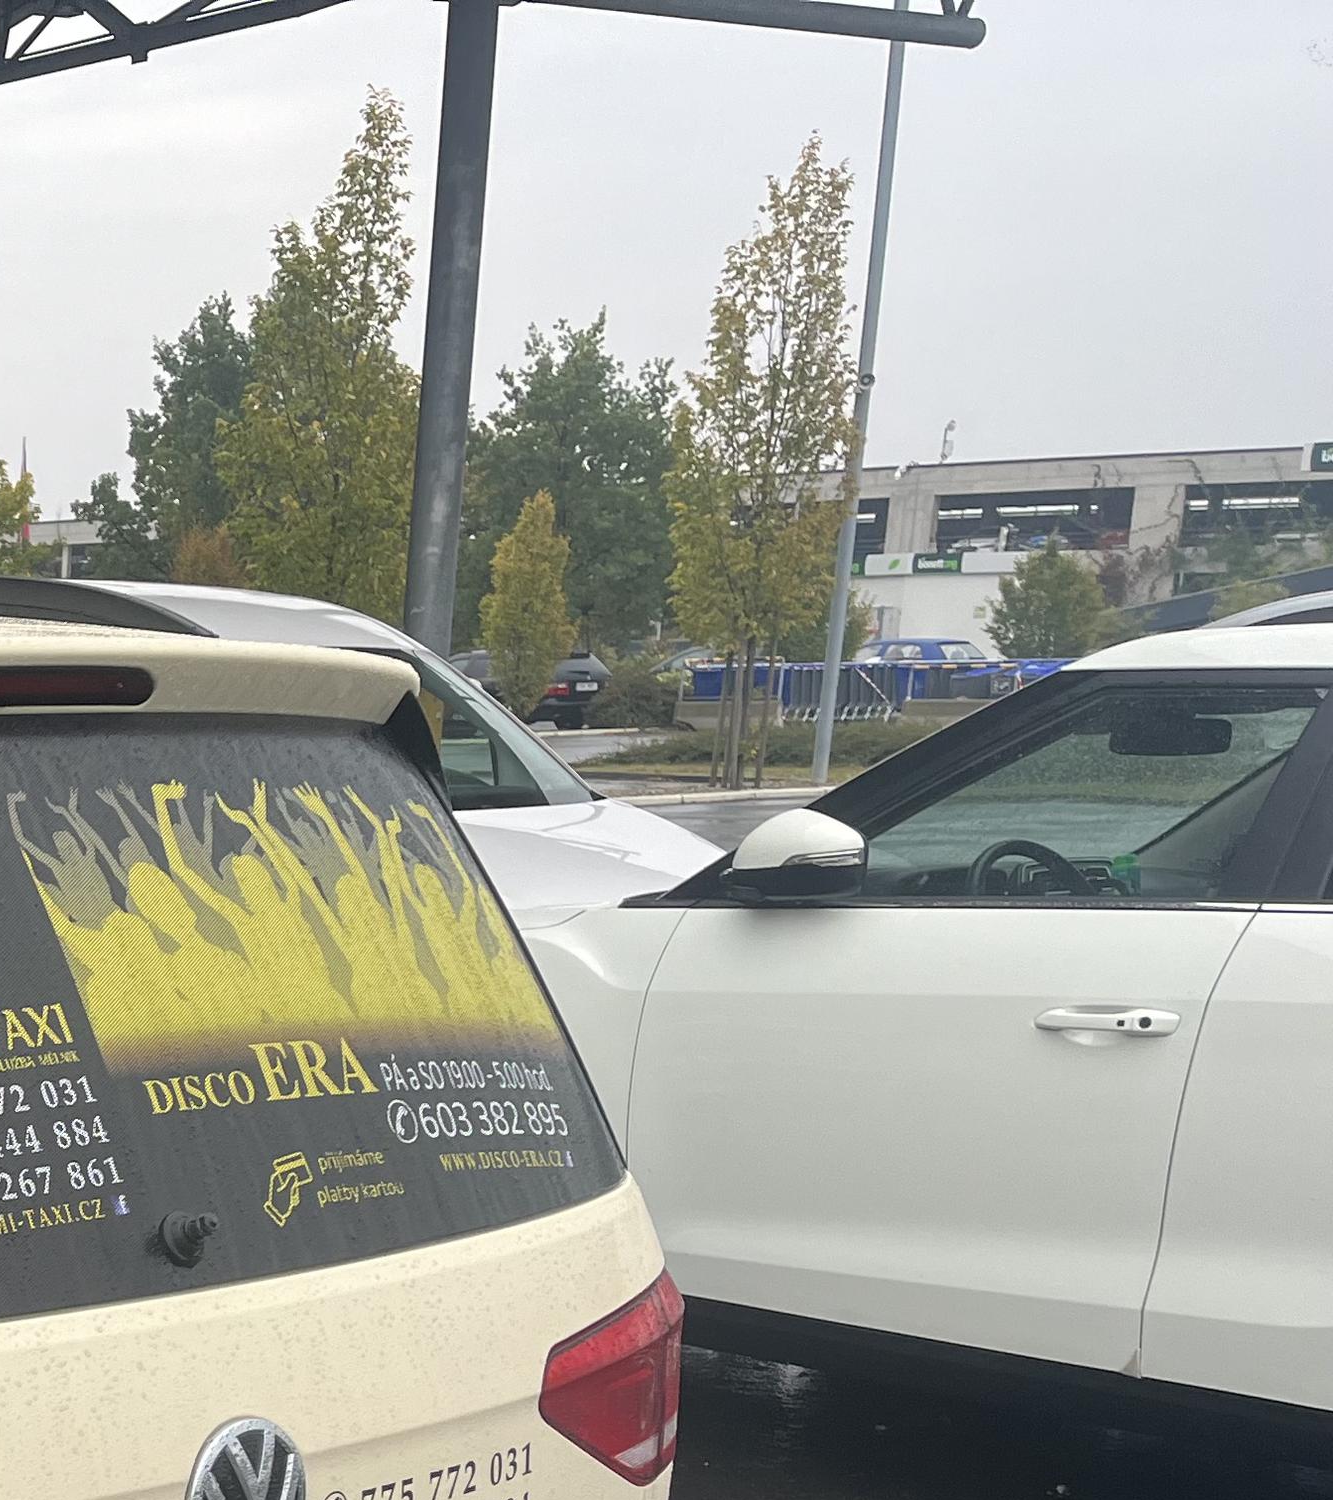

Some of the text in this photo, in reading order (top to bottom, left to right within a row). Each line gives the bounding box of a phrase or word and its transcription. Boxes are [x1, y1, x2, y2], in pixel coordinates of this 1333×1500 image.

[142, 1036, 380, 1115] DISCO ERA
[379, 1053, 410, 1092] PÁ
[417, 1060, 445, 1090] SO
[39, 1075, 98, 1108] 031
[52, 1115, 111, 1150] 884
[418, 1101, 569, 1139] 603 382 895
[66, 1156, 125, 1191] 861
[439, 1151, 565, 1173] WWW.DISCO-ERA.CZ
[316, 1180, 406, 1208] platby kartou
[489, 1441, 533, 1487] 031
